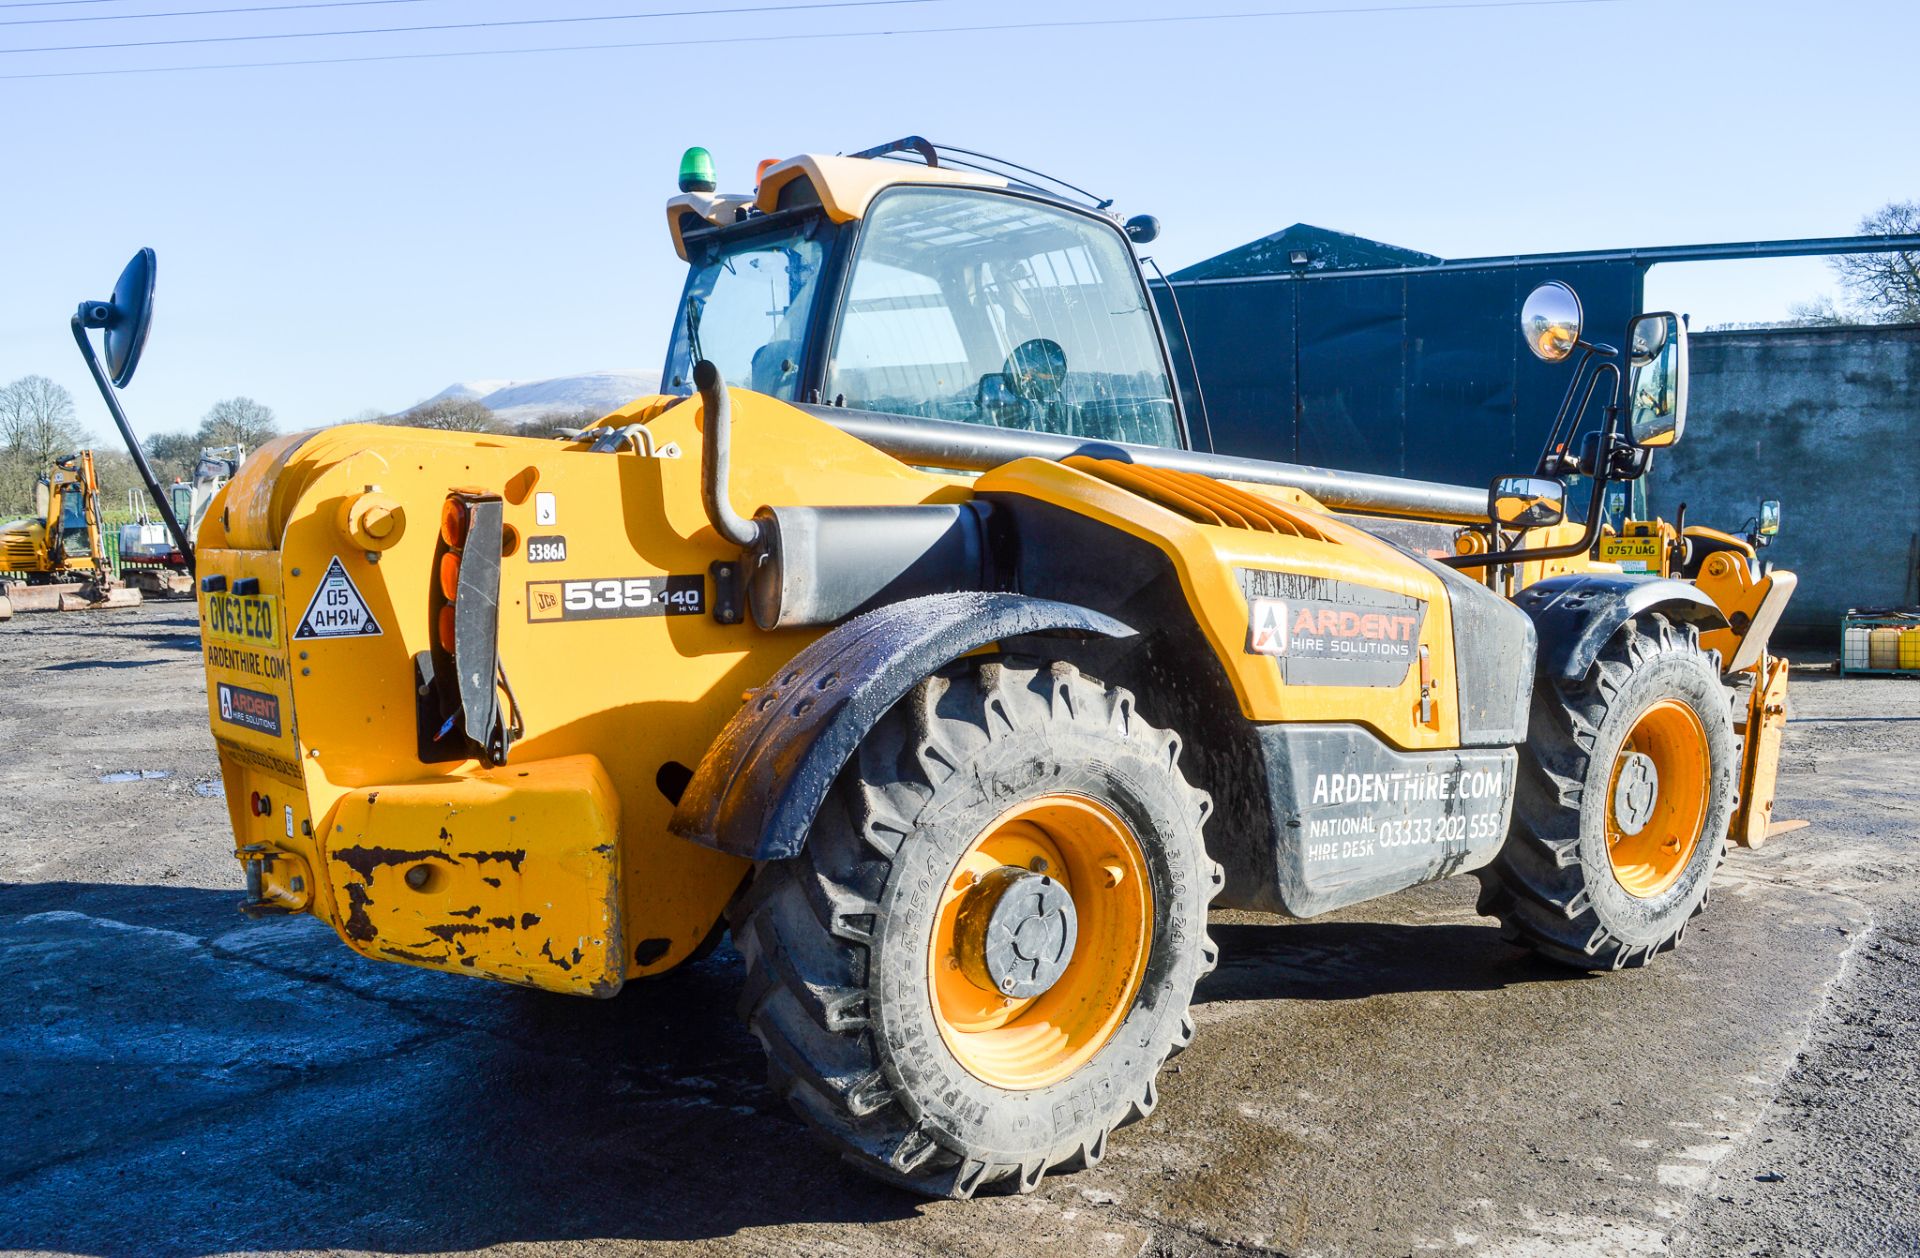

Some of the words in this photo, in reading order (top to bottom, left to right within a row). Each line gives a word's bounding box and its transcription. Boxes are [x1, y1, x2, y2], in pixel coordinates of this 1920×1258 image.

[529, 543, 566, 561] 5386A
[1635, 545, 1655, 555] UAG
[538, 593, 557, 610] JCB
[210, 596, 243, 635] OV63
[244, 599, 272, 640] EZO
[1293, 608, 1416, 641] ARDENT
[1291, 638, 1324, 650] HIRE
[1330, 640, 1410, 656] SOLUTIONS
[208, 645, 286, 681] ARDENTHIRE.COM
[232, 692, 276, 719] ARDENT
[245, 714, 277, 730] SOLUTIONS
[1312, 772, 1502, 804] ARDENTHIRE.COM
[1310, 816, 1376, 838] NATIONAL
[1380, 818, 1432, 848] 03333
[1436, 816, 1466, 842] 202
[1469, 813, 1499, 839] 555
[1308, 842, 1339, 862] HIRE
[1343, 839, 1376, 859] DESK
